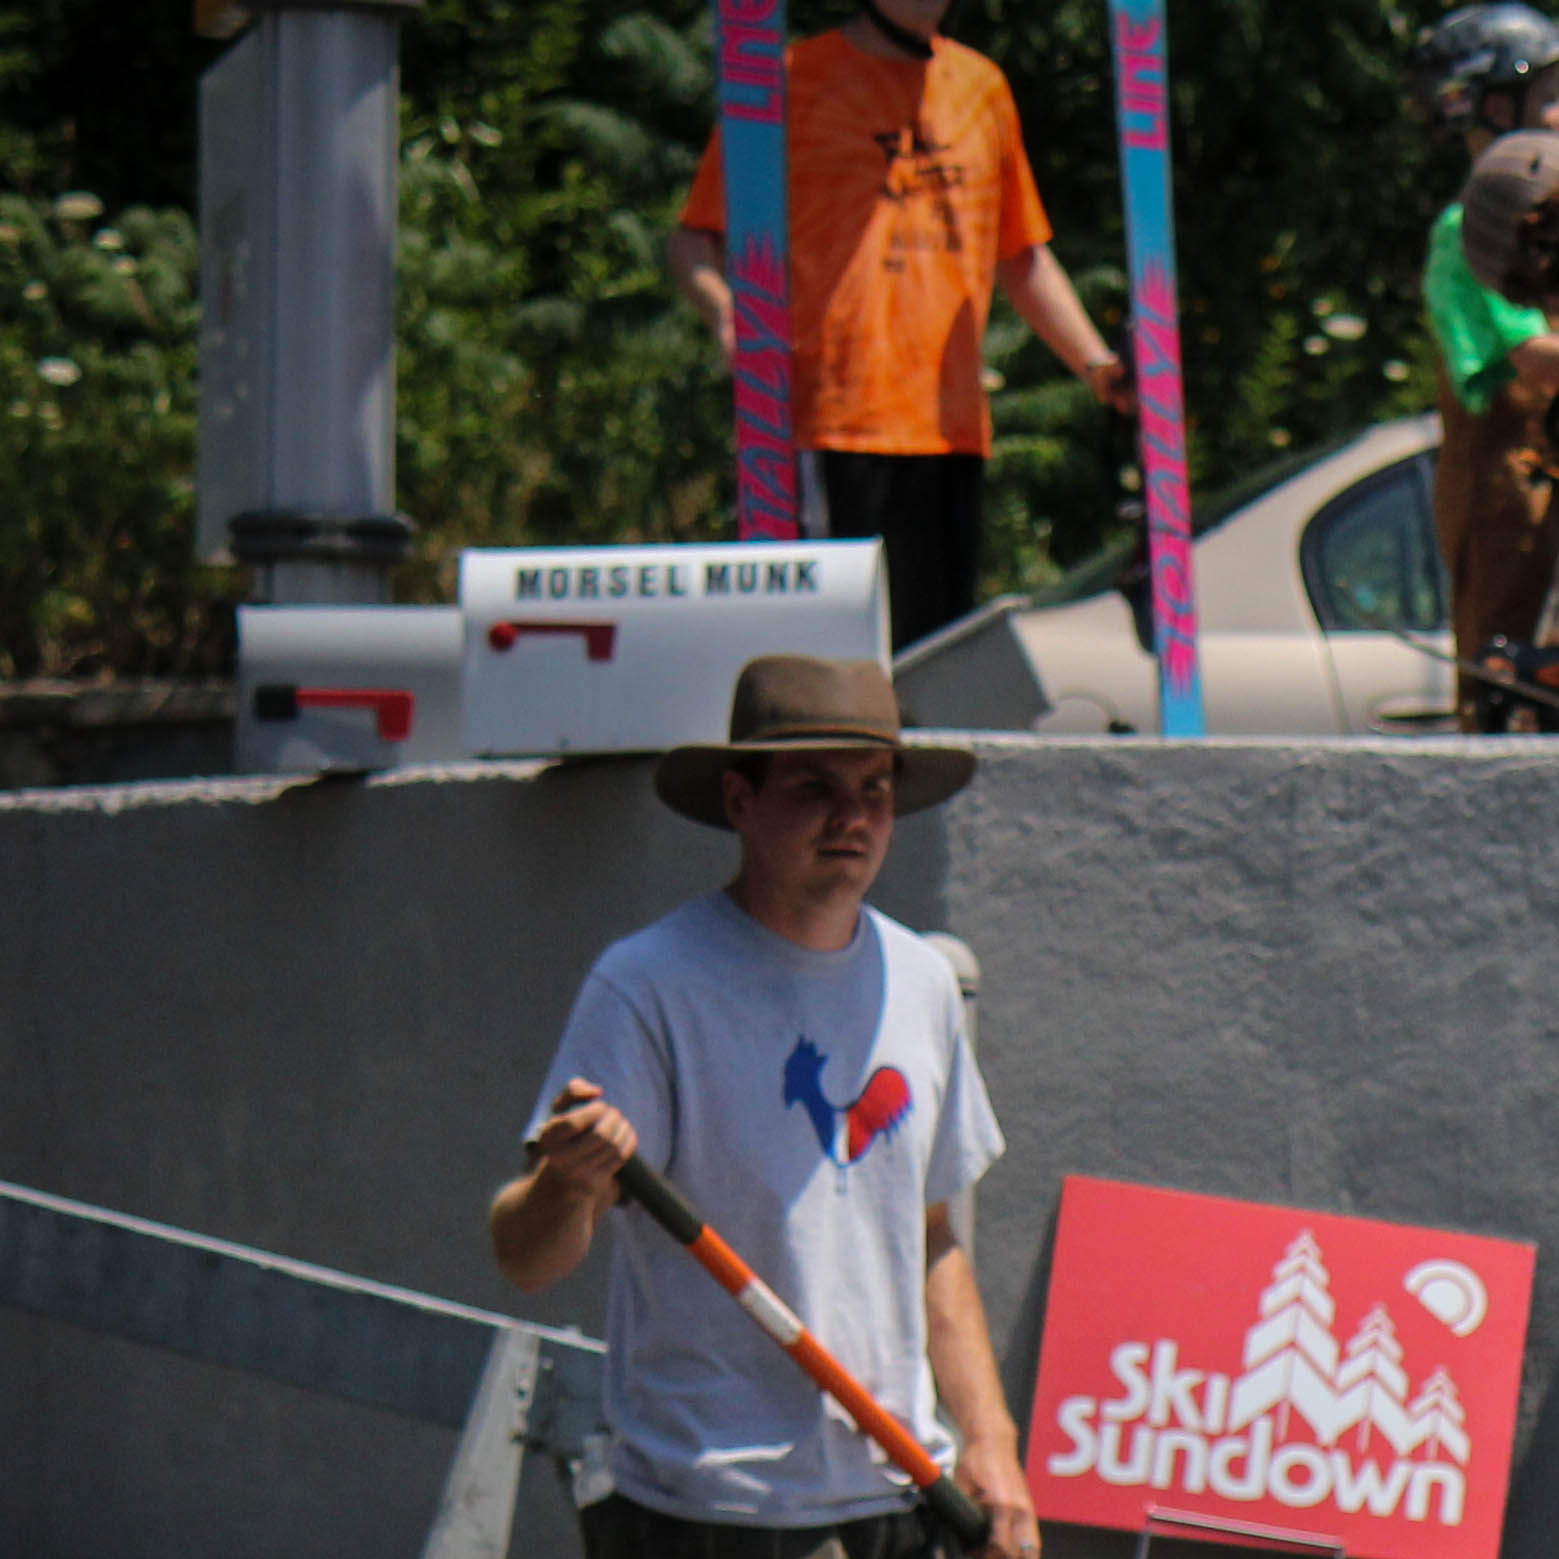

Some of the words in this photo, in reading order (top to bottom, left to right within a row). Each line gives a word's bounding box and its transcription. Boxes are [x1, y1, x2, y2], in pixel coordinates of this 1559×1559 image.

[1116, 10, 1169, 151] LINE
[515, 564, 689, 601] MORSEL
[705, 558, 819, 593] MUNK
[1101, 1338, 1231, 1436] Ski
[1047, 1396, 1466, 1527] Sundown
